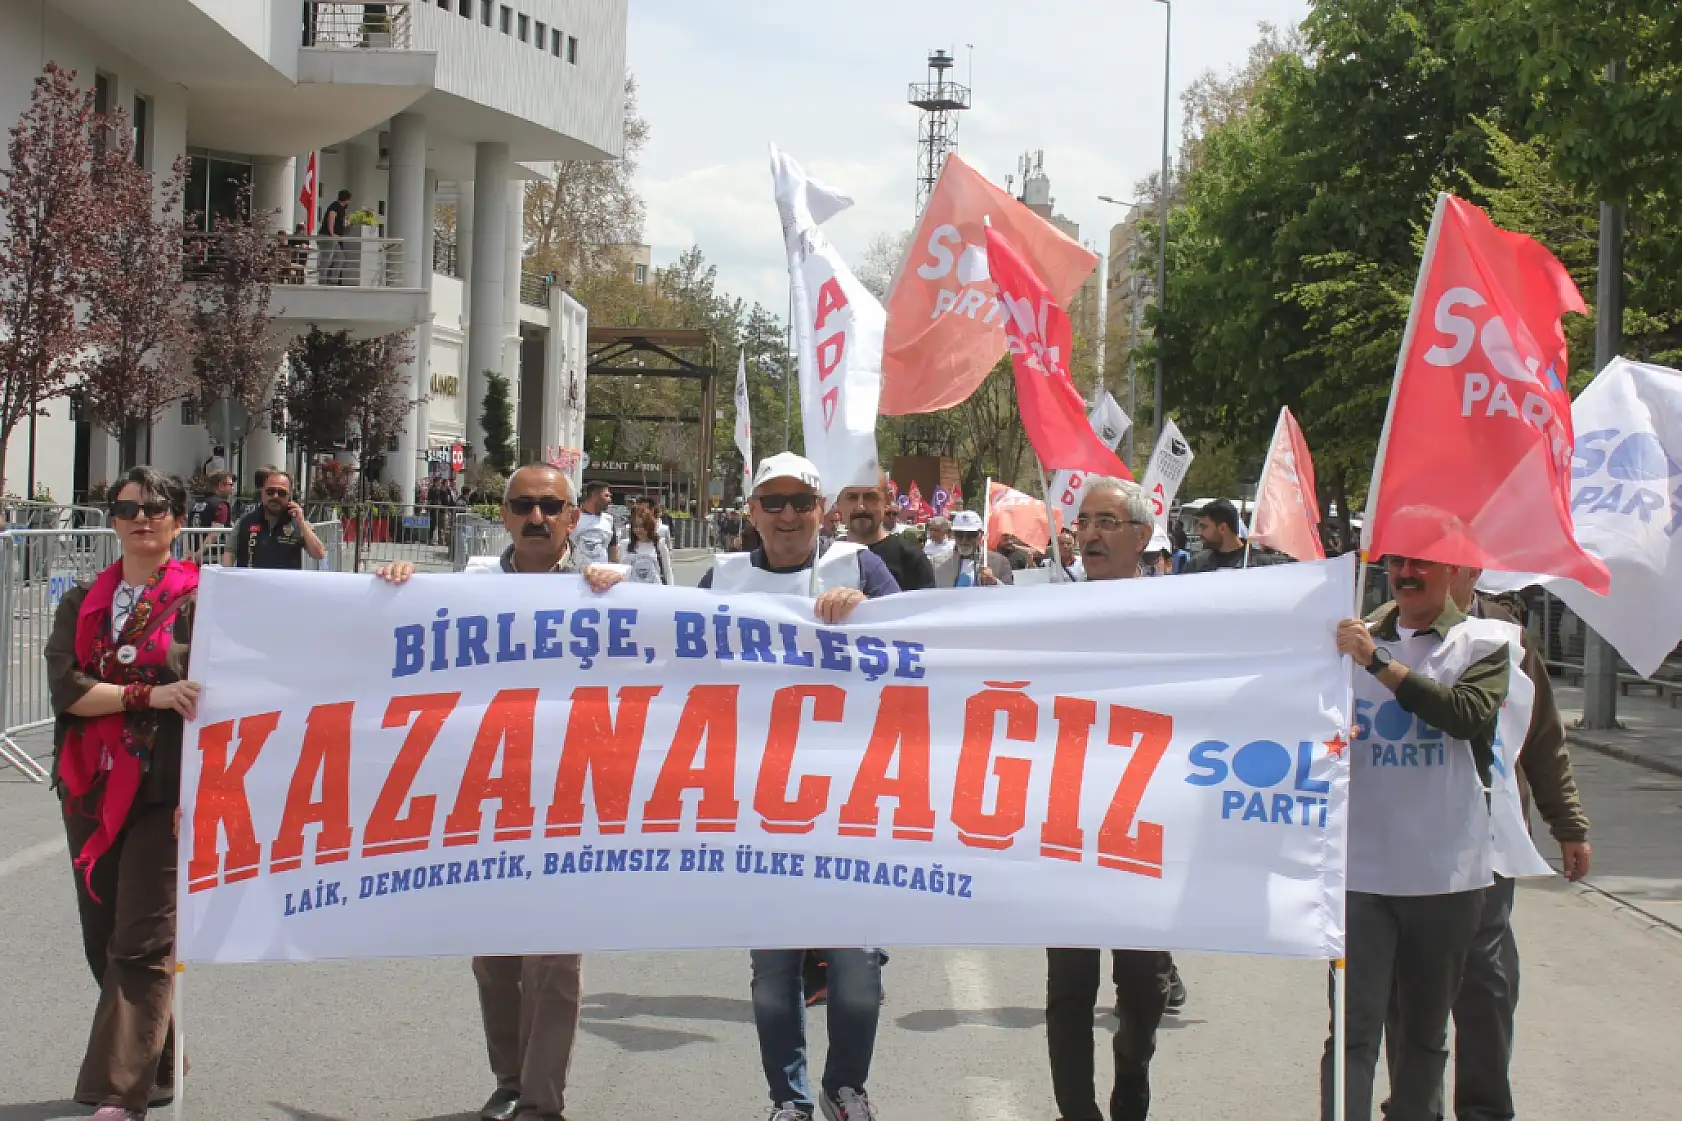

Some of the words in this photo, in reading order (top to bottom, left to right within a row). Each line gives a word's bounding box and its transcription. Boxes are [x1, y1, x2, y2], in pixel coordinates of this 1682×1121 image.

[391, 607, 656, 679] BİRLEŞE,
[673, 604, 926, 682] BİRLEŞE
[189, 681, 1173, 893] KAZANACAĞIZ
[1184, 739, 1330, 795] SOL
[283, 880, 348, 917] LAİK,
[358, 850, 532, 900] DEMOKRATİK,
[542, 844, 671, 875] BAĞIMSIZ
[679, 843, 725, 872] BİR
[735, 844, 805, 877] ÜLKE
[814, 855, 973, 899] KURACAĞIZ
